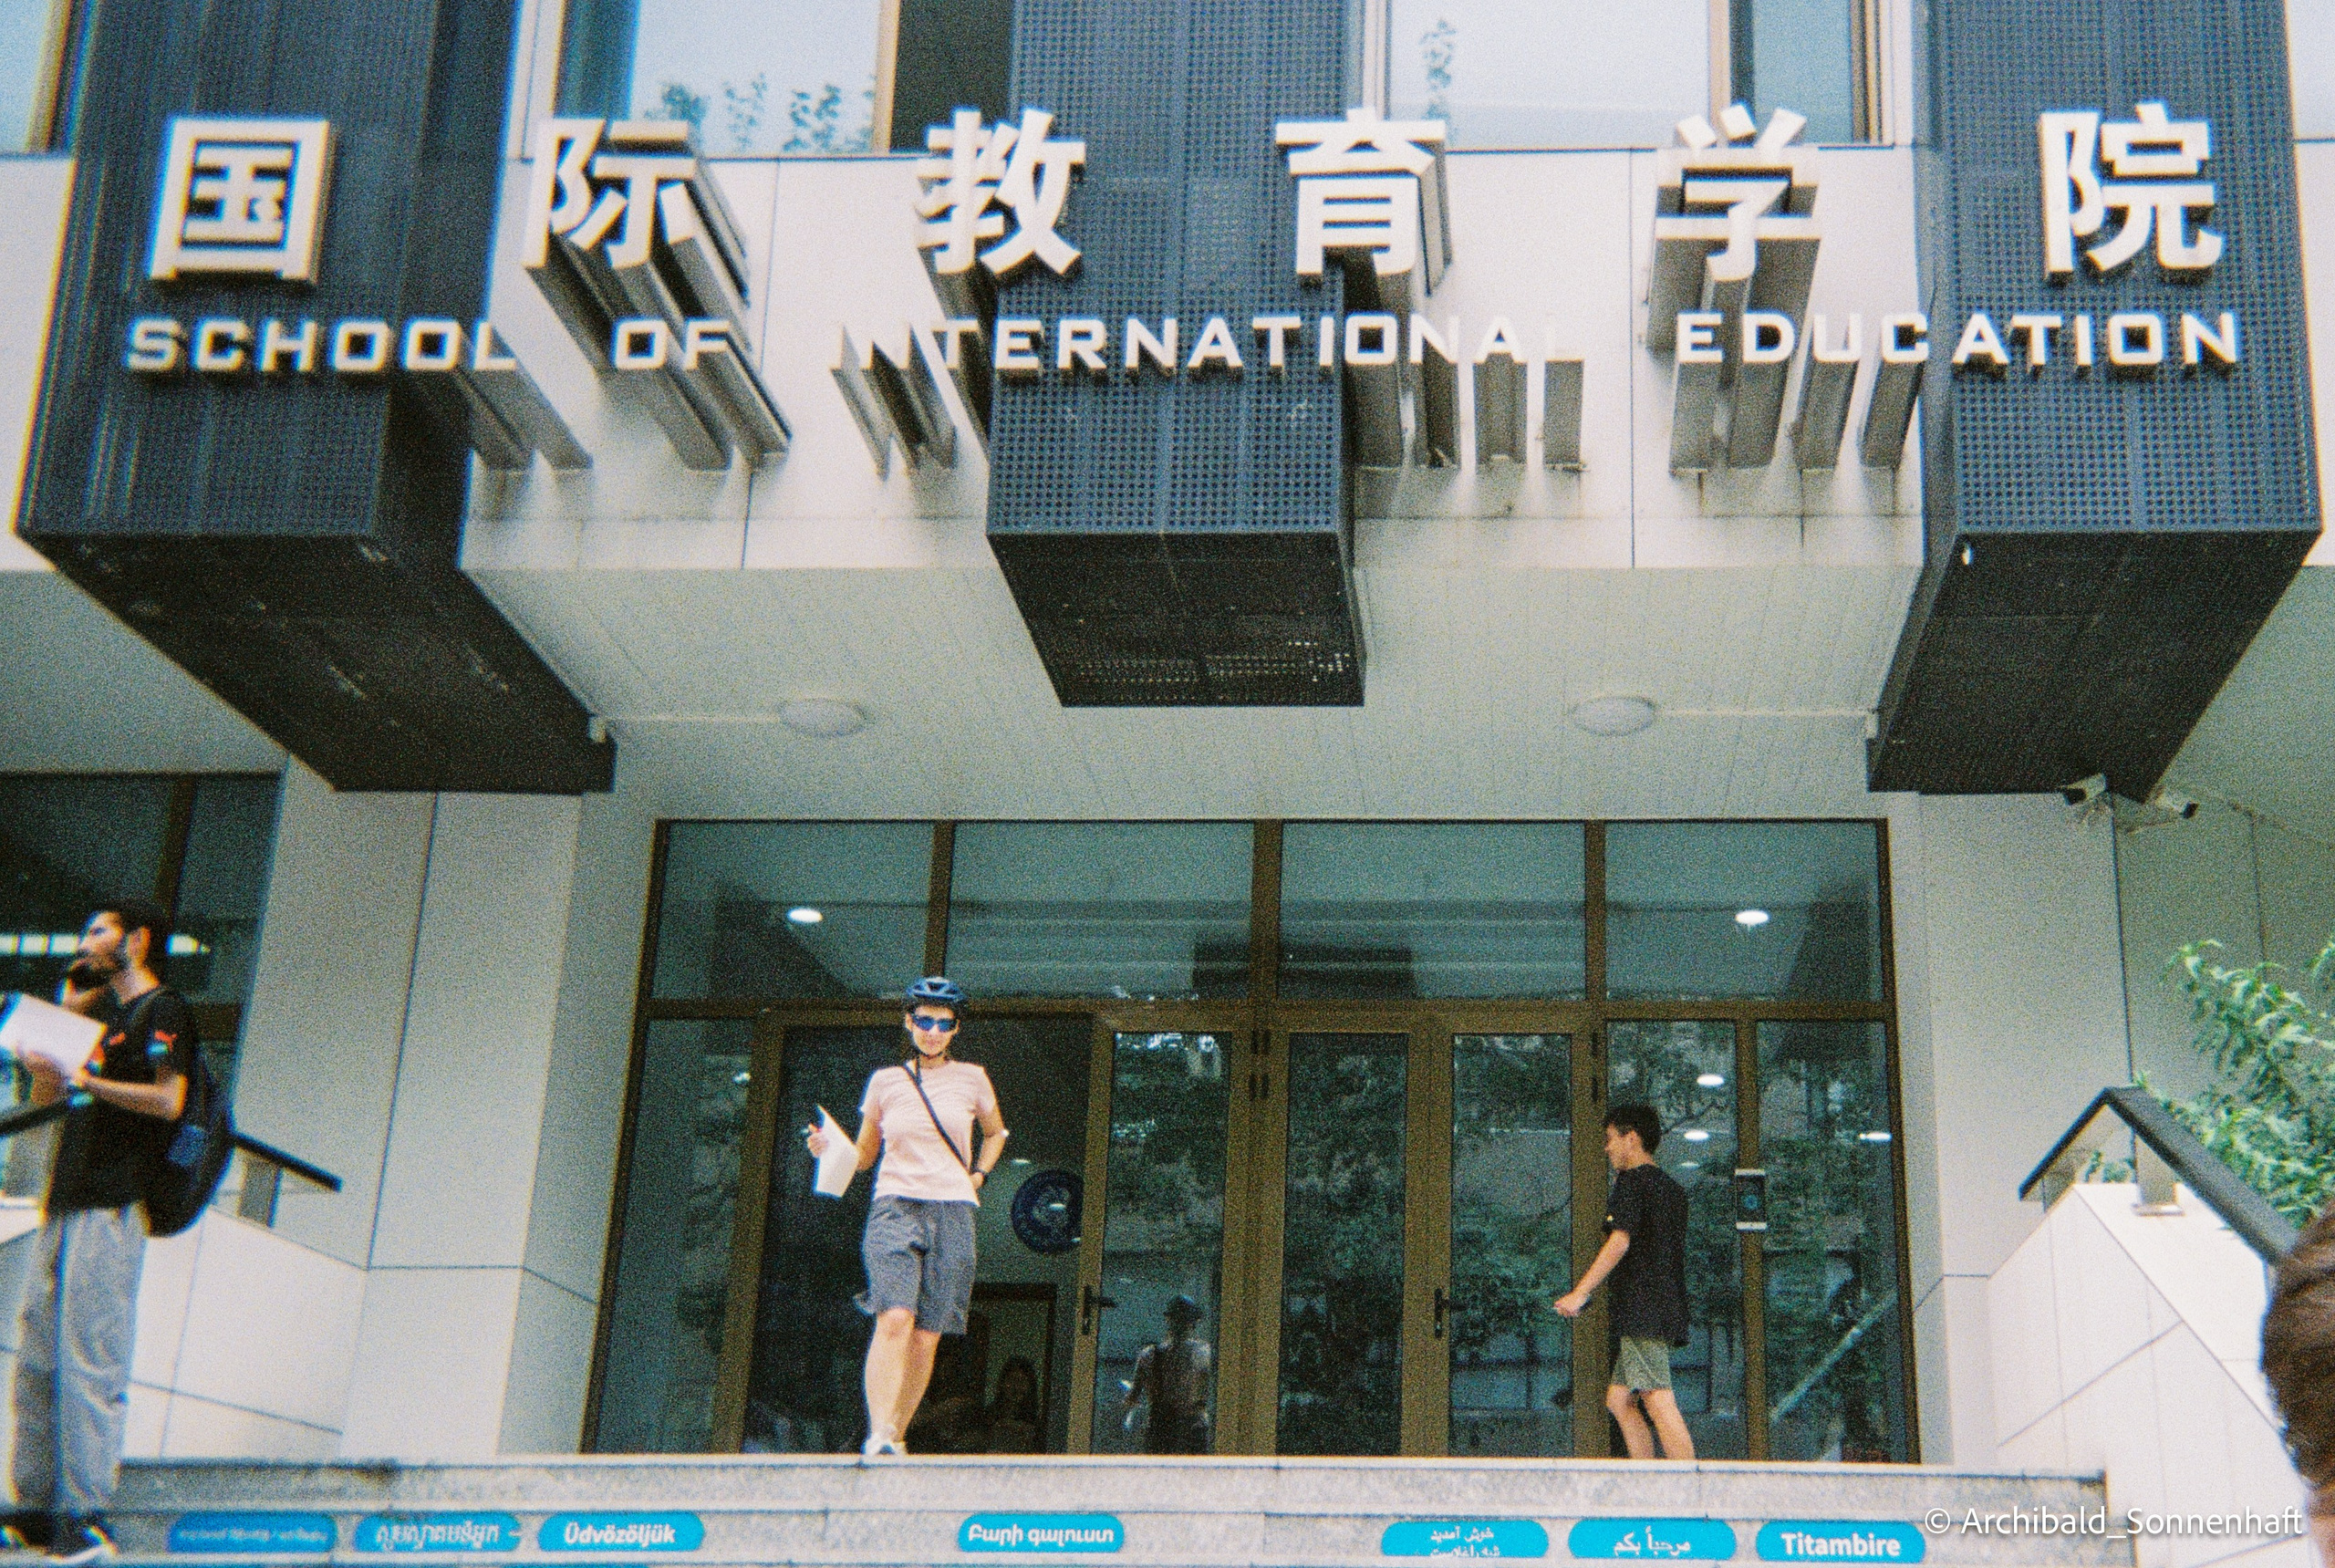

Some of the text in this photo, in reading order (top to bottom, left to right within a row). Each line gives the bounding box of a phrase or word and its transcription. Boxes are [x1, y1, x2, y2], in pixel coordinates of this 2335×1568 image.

[149, 101, 2224, 285] 国际教育学院
[126, 310, 2239, 373] SCHOOL OF INTERNATIONAL EDUCATION
[564, 1521, 676, 1548] Üdvözöljük
[968, 1522, 1115, 1547] Բարի գալուստ
[1464, 1526, 1495, 1542] خوش
[1614, 1532, 1641, 1556] بكم
[1780, 1532, 1902, 1557] Titambire
